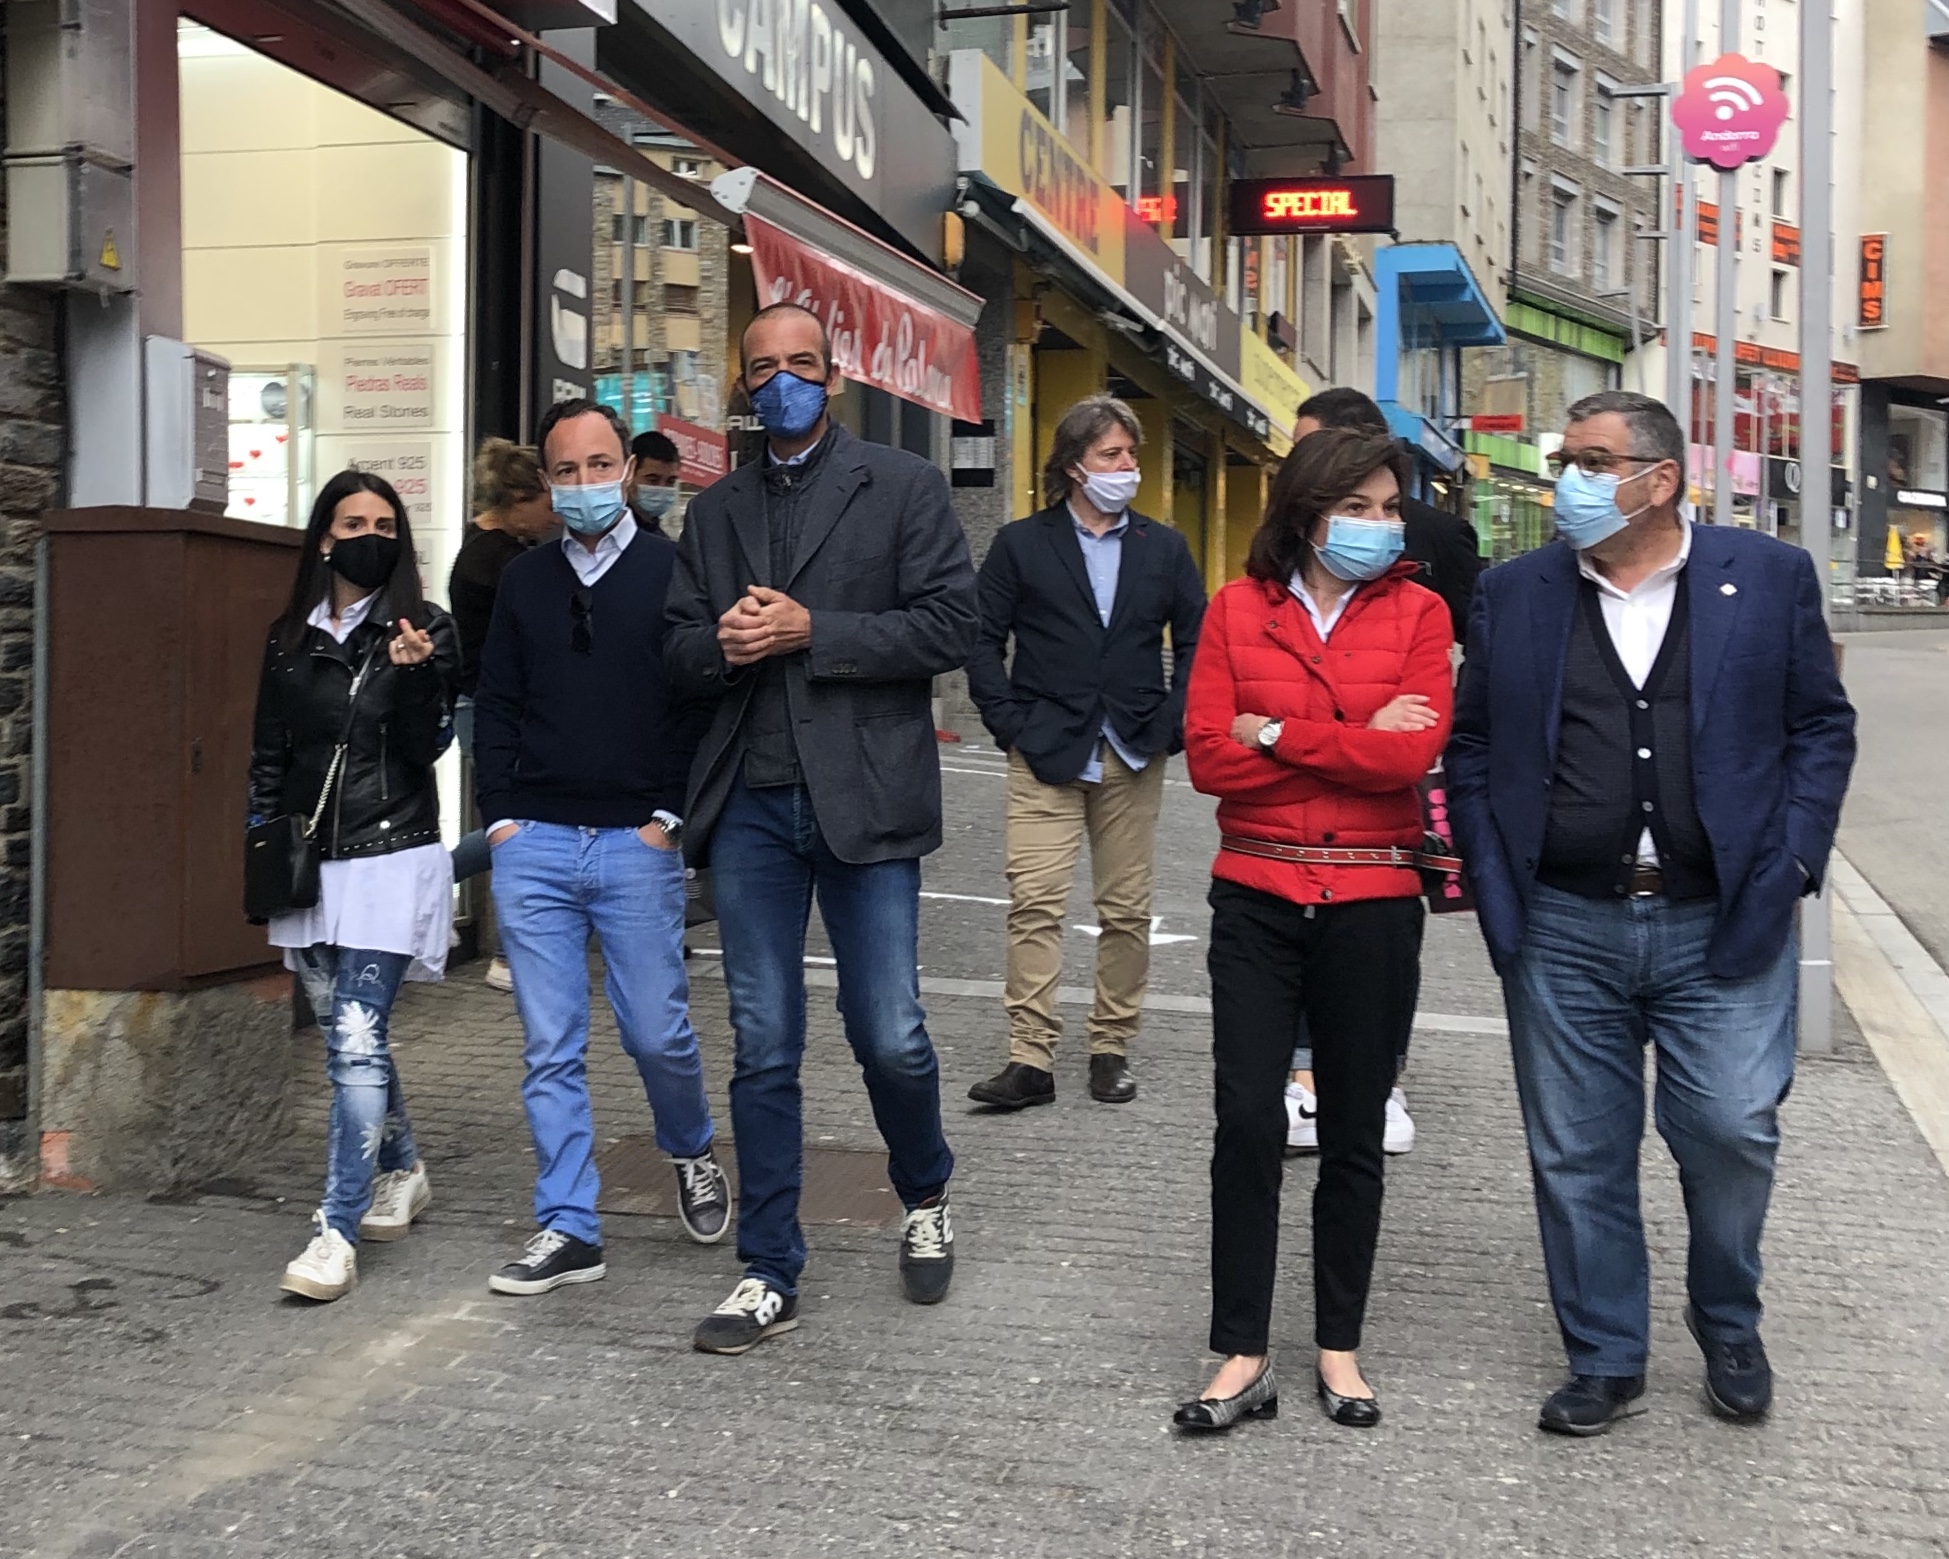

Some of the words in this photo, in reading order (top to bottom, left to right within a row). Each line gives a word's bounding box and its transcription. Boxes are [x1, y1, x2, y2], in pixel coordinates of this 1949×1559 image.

[1700, 129, 1759, 141] Andorra
[1264, 190, 1358, 219] SPECIAL
[384, 277, 429, 297] OFERT
[1861, 241, 1883, 320] CIMS
[343, 404, 374, 419] Real
[380, 404, 430, 418] Stones
[397, 455, 428, 471] 925
[393, 478, 428, 495] 925
